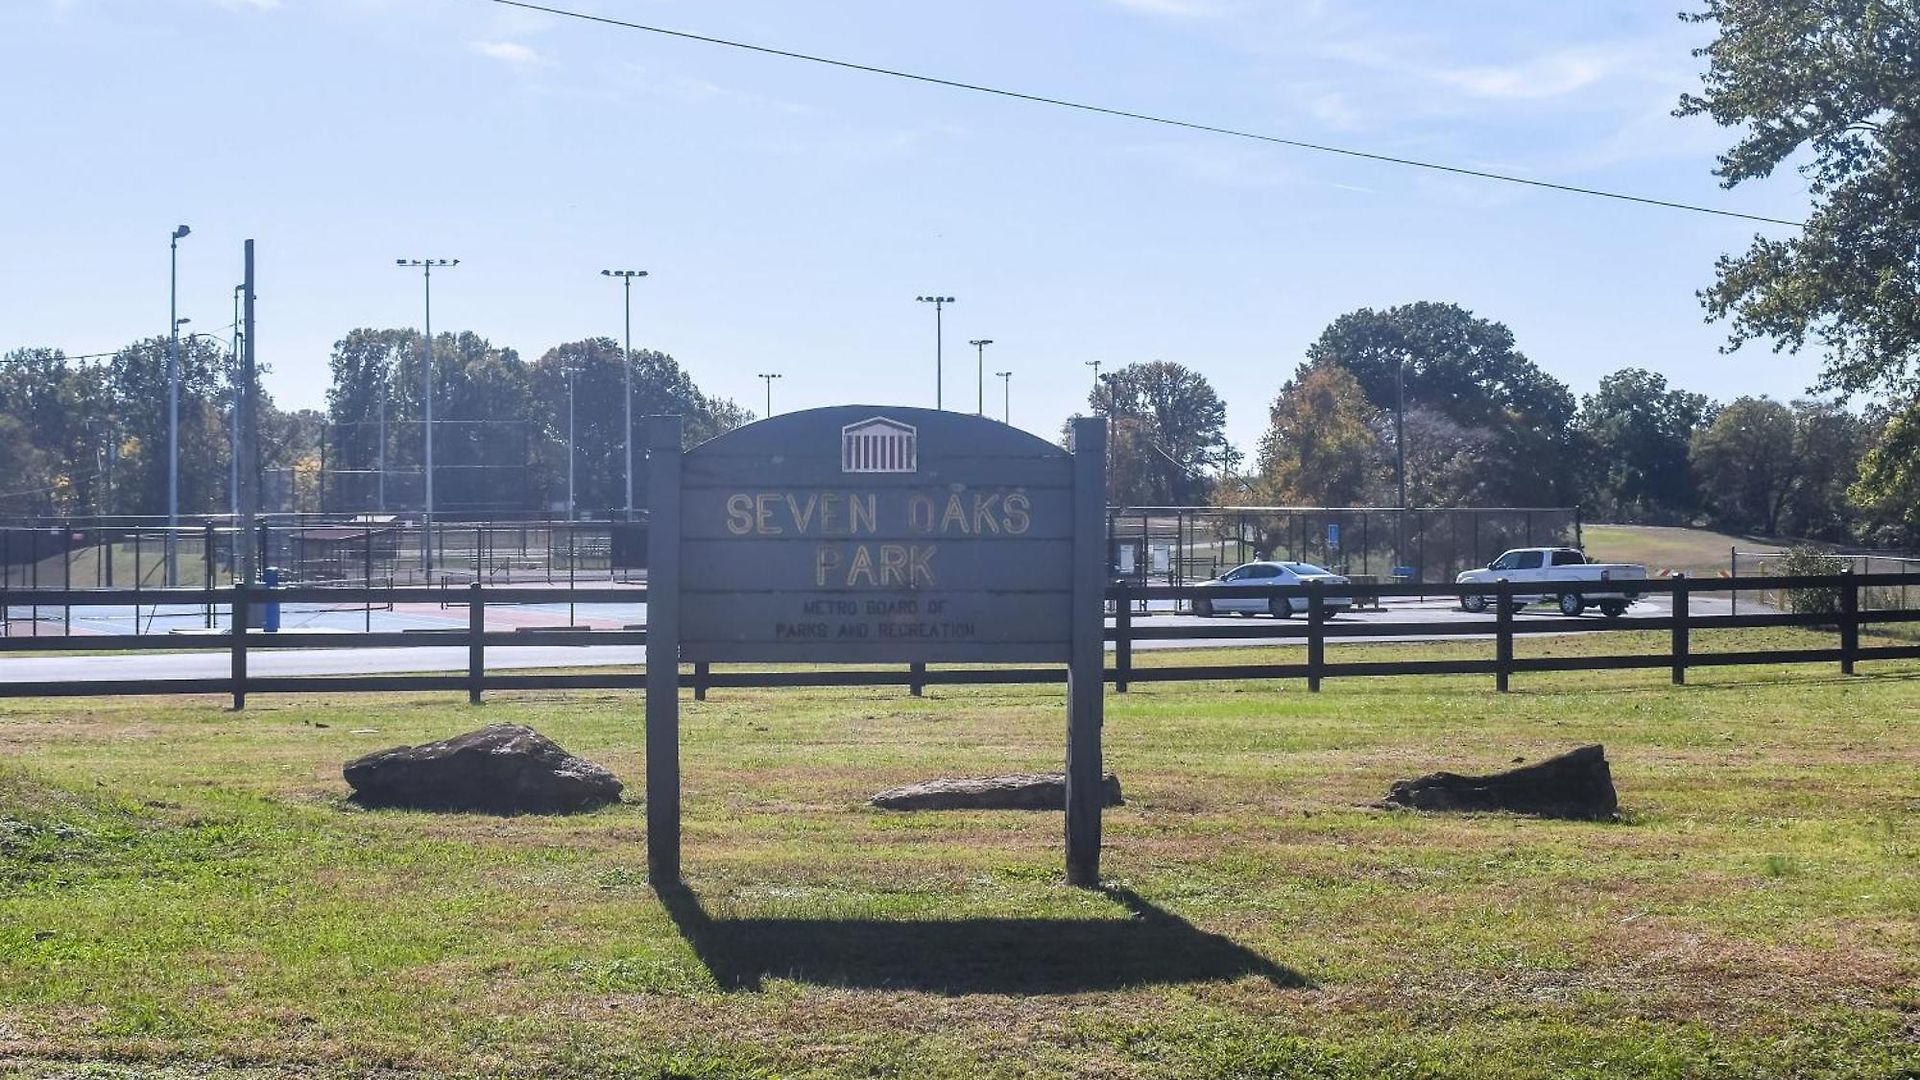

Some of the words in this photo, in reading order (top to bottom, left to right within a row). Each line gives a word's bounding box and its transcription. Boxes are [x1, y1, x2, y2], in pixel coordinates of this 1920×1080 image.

[727, 494, 877, 534] SEVEN
[908, 493, 1031, 534] OAKS
[816, 544, 938, 586] PARK
[803, 600, 857, 616] METRO
[866, 600, 919, 616] BOARD
[927, 600, 947, 615] OF
[775, 622, 828, 639] PARKS
[837, 622, 869, 639] AND
[878, 622, 976, 639] RECREATION
